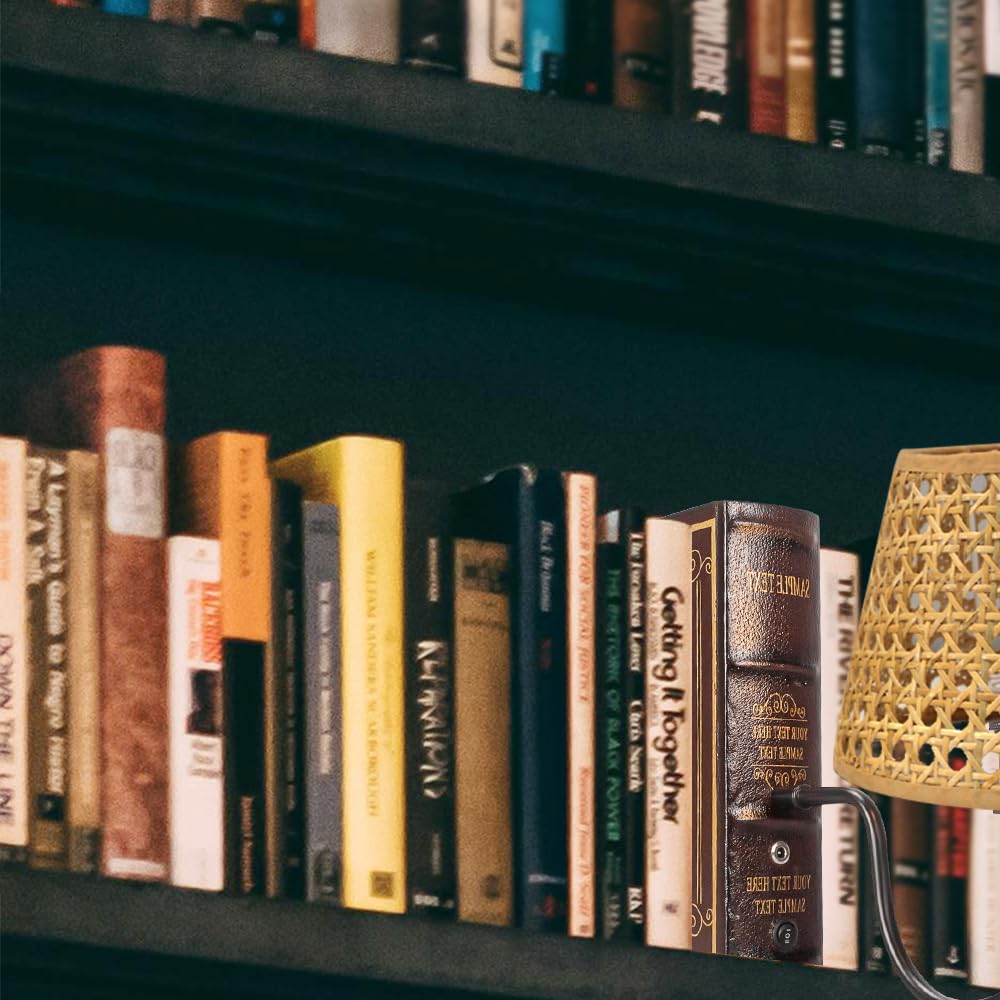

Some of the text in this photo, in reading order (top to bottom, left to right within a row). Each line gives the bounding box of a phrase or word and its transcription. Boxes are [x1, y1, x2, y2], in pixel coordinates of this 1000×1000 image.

[579, 485, 591, 551] PIONEER
[629, 533, 643, 557] The
[579, 555, 591, 585] FOR
[606, 568, 621, 598] THE
[838, 575, 856, 625] THE
[653, 586, 685, 682] Getting
[606, 688, 621, 711] OF
[668, 687, 685, 701] It
[606, 717, 621, 769] BLACK
[629, 700, 643, 741] Chris
[653, 708, 685, 825] Together
[606, 779, 621, 842] POWER
